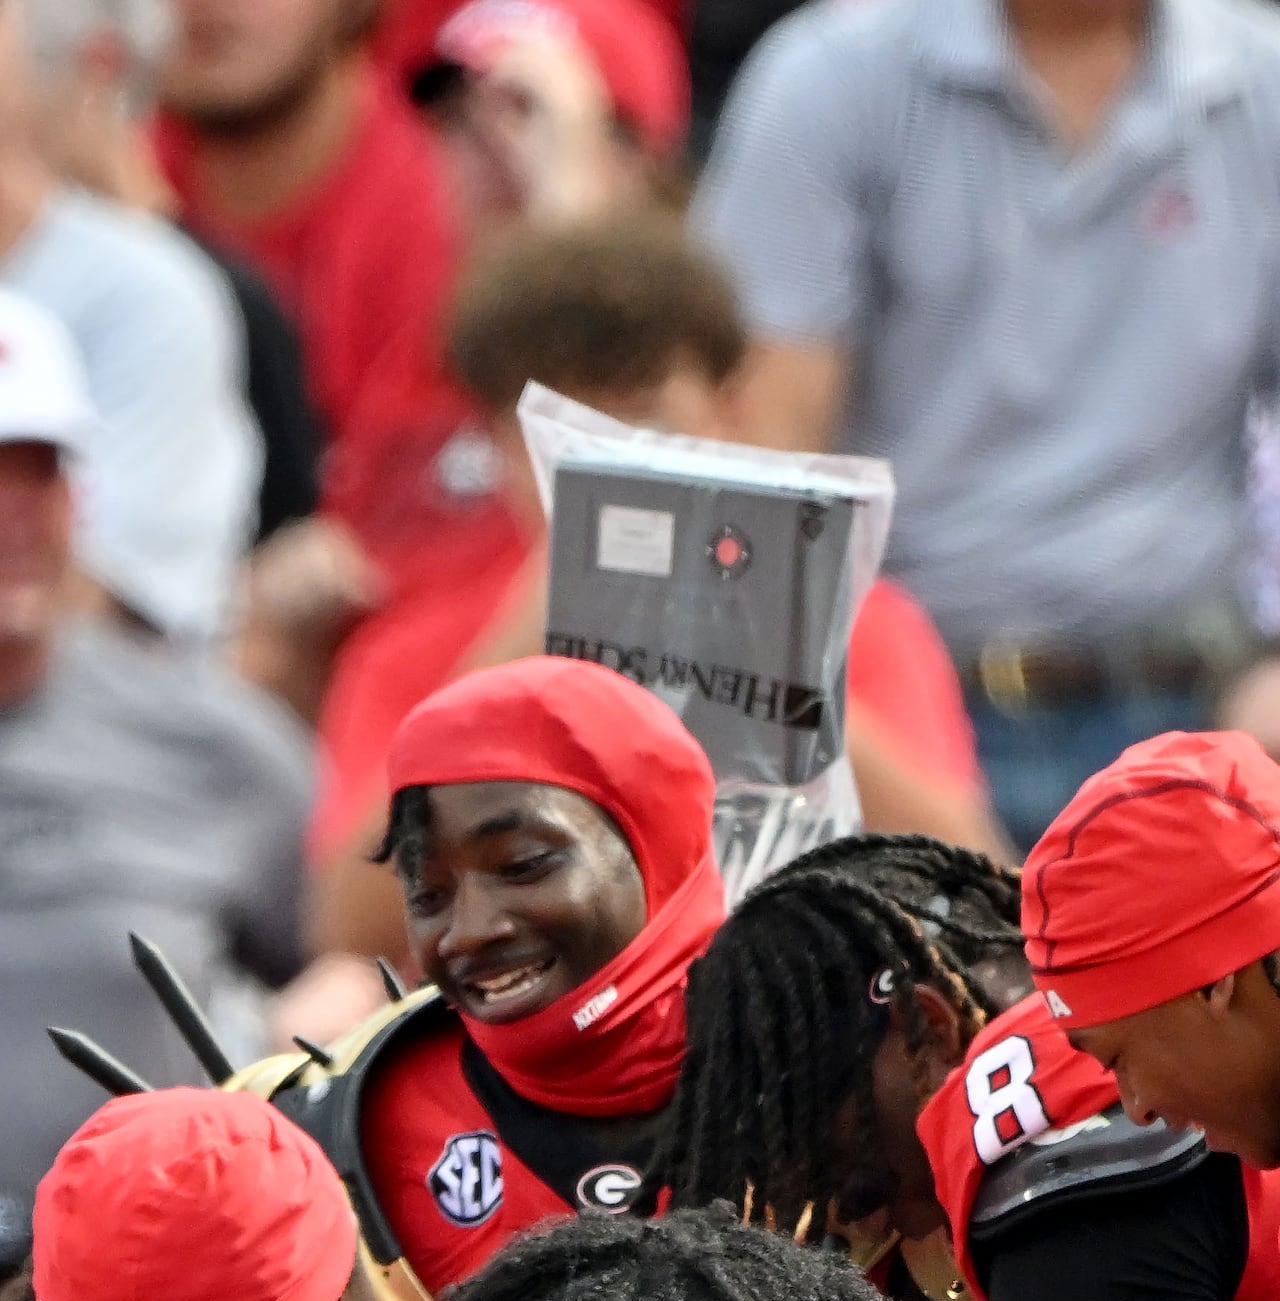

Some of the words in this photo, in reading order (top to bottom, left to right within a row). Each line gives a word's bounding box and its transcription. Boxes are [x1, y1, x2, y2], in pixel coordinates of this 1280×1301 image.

[658, 652, 778, 722] HENRY
[965, 1035, 1051, 1166] 8
[434, 1133, 504, 1218] SEC
